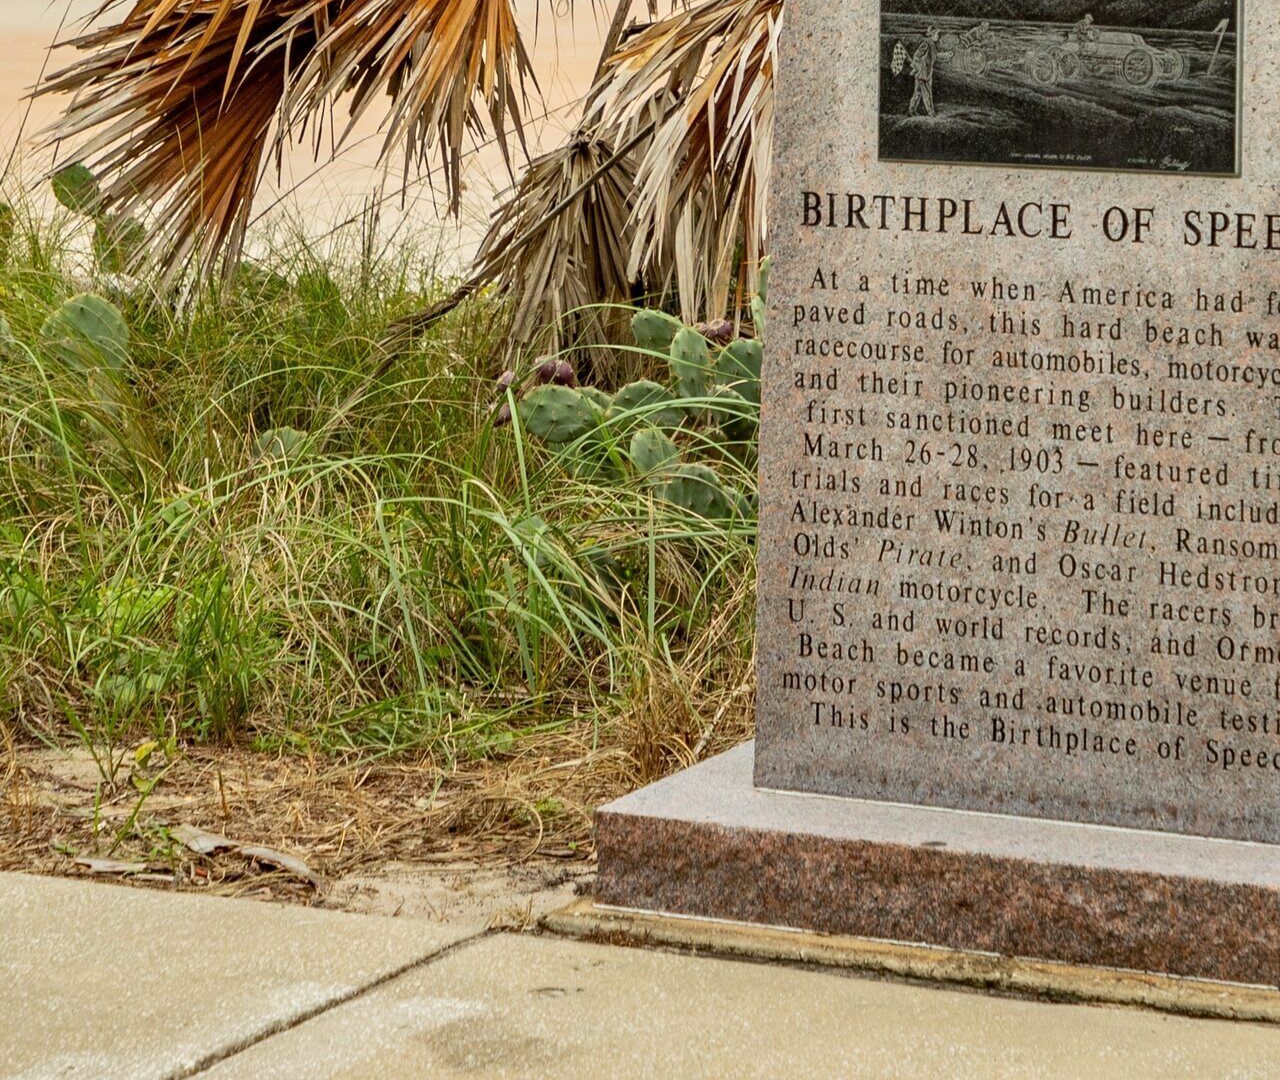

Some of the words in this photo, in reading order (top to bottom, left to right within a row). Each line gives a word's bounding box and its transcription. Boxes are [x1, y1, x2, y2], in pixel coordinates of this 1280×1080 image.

[801, 191, 1072, 240] BIRTHPLACE
[1102, 206, 1154, 243] OF
[811, 267, 838, 290] At
[859, 275, 869, 291] a
[892, 271, 949, 296] time
[971, 276, 1035, 300] when
[1059, 280, 1172, 309] America
[1196, 288, 1243, 313] had
[793, 303, 865, 326] paved
[887, 307, 968, 334] roads,
[989, 311, 1041, 335] this
[1062, 315, 1121, 340] hard
[1146, 319, 1223, 347] beach
[795, 338, 924, 362] racecourse
[943, 341, 974, 365] for
[992, 348, 1150, 380] automobiles,
[795, 368, 838, 390] and
[859, 371, 923, 396] their
[945, 376, 1090, 412] pioneering
[1113, 386, 1235, 417] builders.
[807, 400, 866, 426] first
[887, 408, 1029, 437] sanctioned
[1052, 422, 1114, 444] meet
[1137, 424, 1192, 448] here
[803, 433, 883, 461] March
[905, 440, 988, 471] 26-28,
[1009, 447, 1063, 474] 1903
[1114, 455, 1228, 486] featured
[791, 468, 860, 493] trials
[879, 476, 922, 497] and
[944, 484, 1009, 505] races
[1029, 483, 1063, 508] for
[1084, 494, 1094, 510] a
[1116, 489, 1175, 517] field
[791, 500, 915, 531] Alexander
[934, 509, 1046, 541] Winton's
[1063, 520, 1156, 552] Bullet,
[1176, 528, 1278, 560] Ransom
[794, 533, 859, 560] Olds'
[878, 539, 971, 570] Pirate,
[993, 552, 1037, 575] and
[1059, 554, 1137, 582] Oscar
[790, 565, 880, 595] Indian
[899, 579, 1047, 610] motorcycle.
[1082, 589, 1129, 617] The
[1150, 603, 1232, 627] racers
[788, 599, 814, 624] U.
[832, 603, 853, 628] S.
[872, 610, 915, 632] and
[936, 617, 1003, 640] world
[1025, 626, 1131, 654] records,
[1151, 634, 1196, 657] and
[799, 634, 874, 663] Beach
[897, 642, 994, 673] became
[1015, 659, 1026, 676] a
[1048, 656, 1153, 688] favorite
[1177, 673, 1251, 696] venue
[782, 672, 856, 695] motor
[877, 680, 959, 705] sports
[980, 688, 1024, 710] and
[1046, 695, 1197, 726] automobile
[811, 701, 868, 730] This
[889, 709, 909, 734] is
[931, 716, 970, 739] the
[992, 718, 1136, 756] Birthplace
[1158, 737, 1184, 760] of
